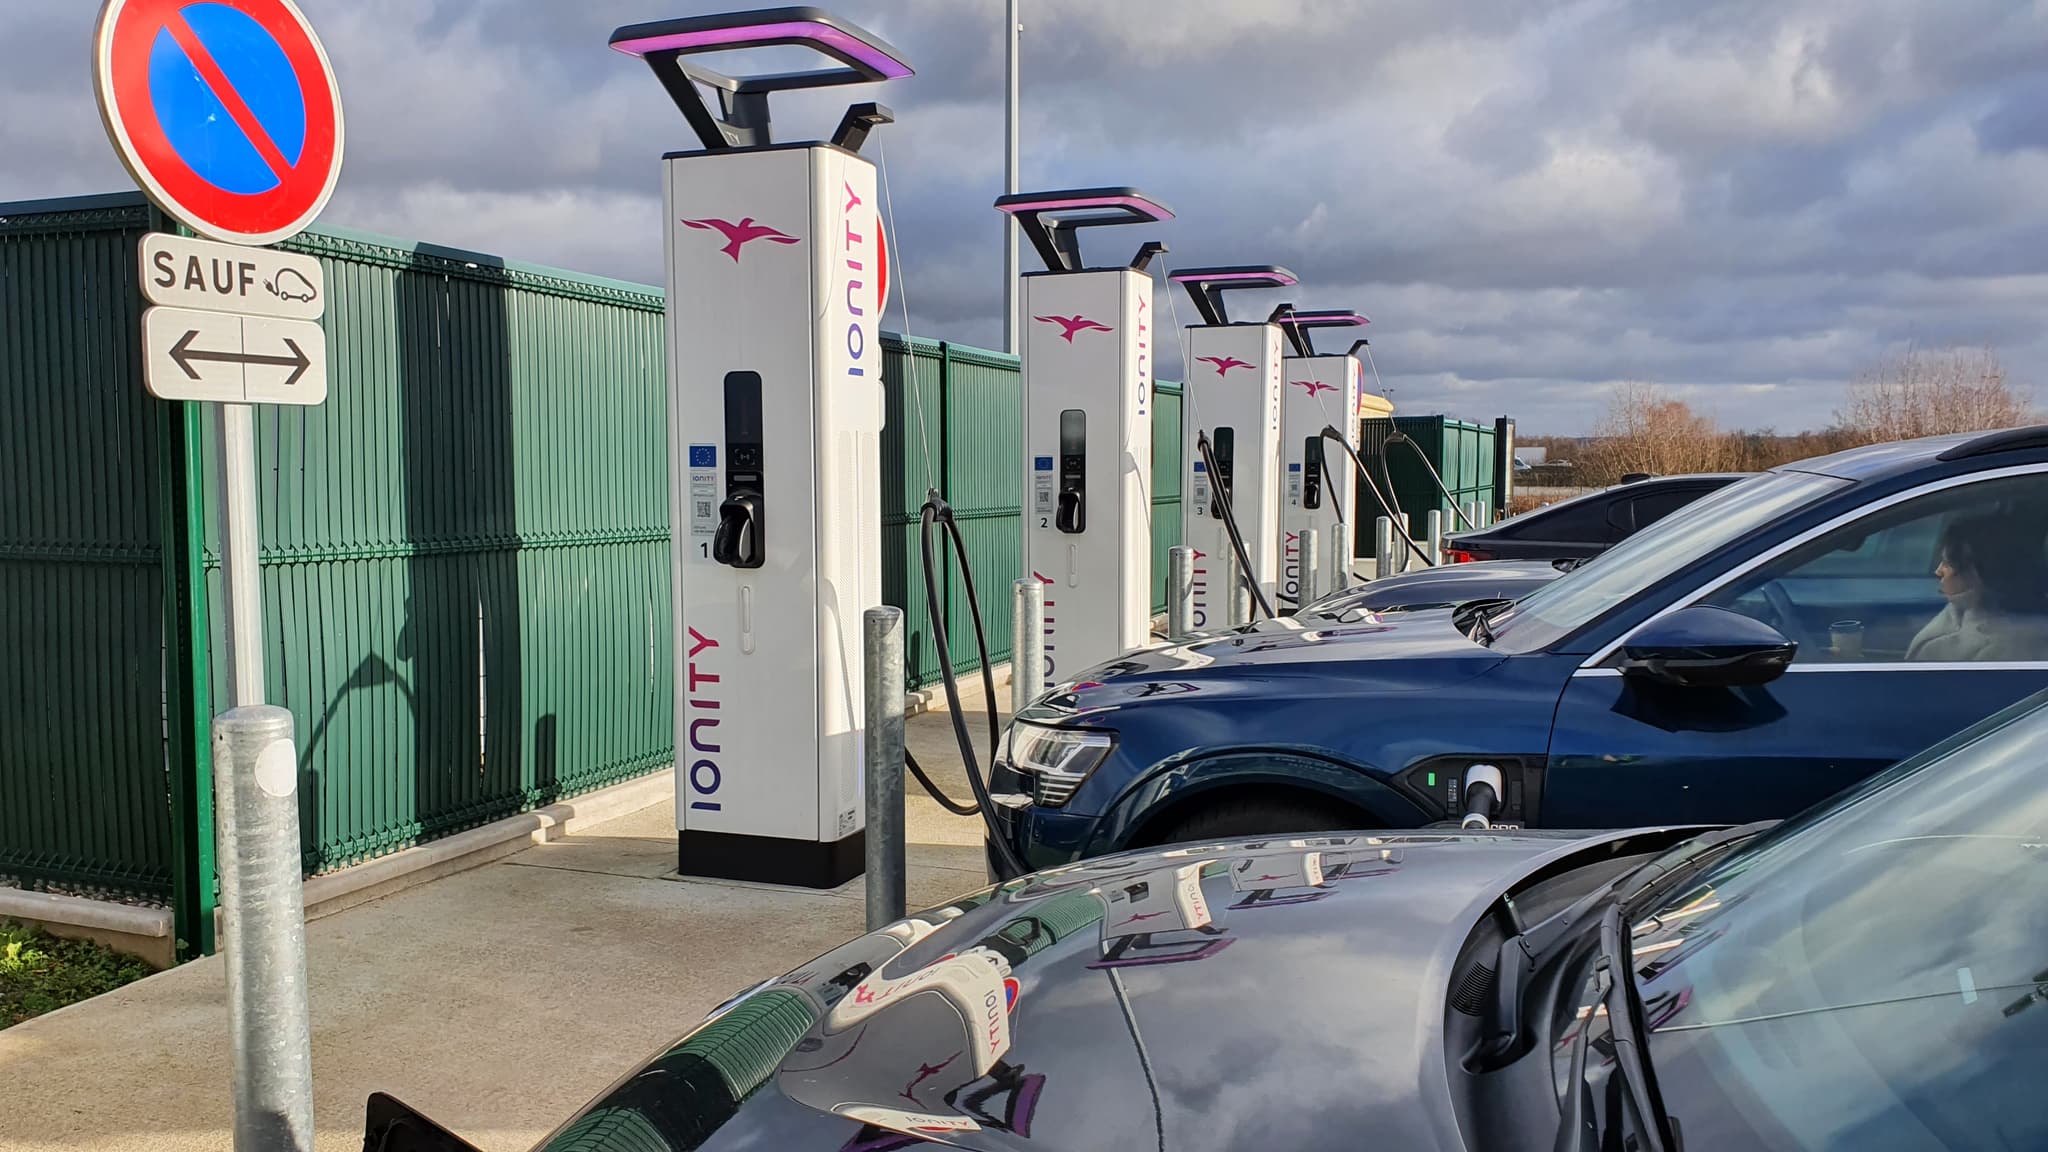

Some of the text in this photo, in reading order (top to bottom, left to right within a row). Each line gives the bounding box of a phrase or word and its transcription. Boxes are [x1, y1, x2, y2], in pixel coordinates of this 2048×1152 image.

[153, 250, 256, 297] SAUF
[844, 180, 864, 377] IONITY
[1138, 293, 1146, 416] IONITY
[1040, 517, 1048, 528] 2
[1197, 506, 1203, 515] 3
[700, 542, 708, 558] 1
[688, 626, 721, 811] IONITY
